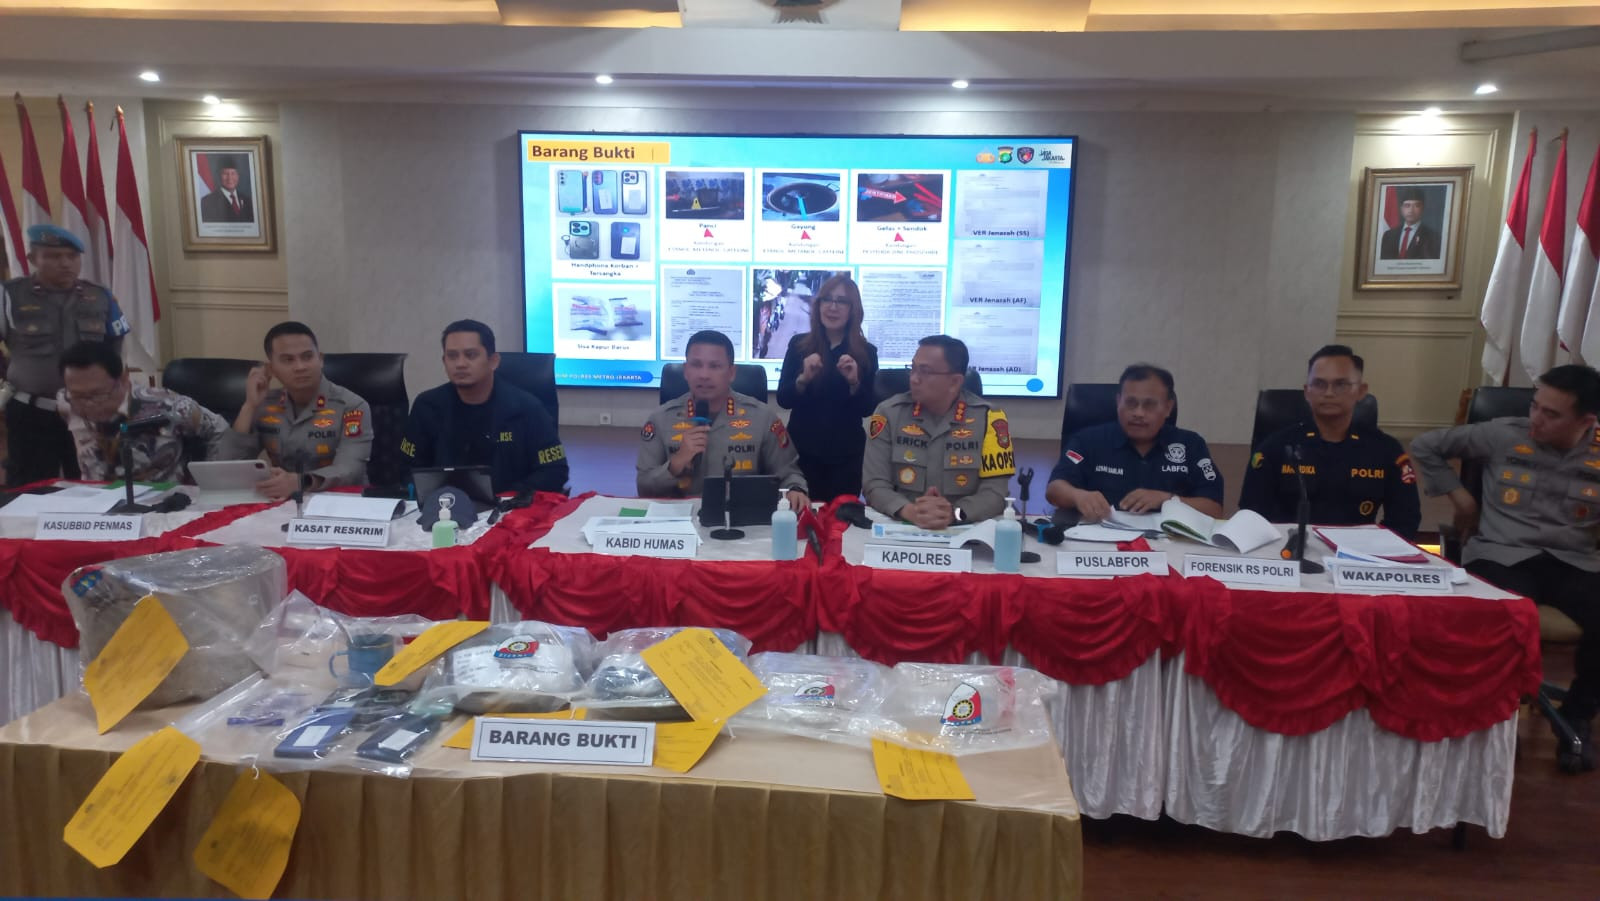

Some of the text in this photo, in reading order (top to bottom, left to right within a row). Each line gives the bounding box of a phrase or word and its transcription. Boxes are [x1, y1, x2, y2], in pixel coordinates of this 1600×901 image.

[532, 145, 635, 160] Barang Bukti
[308, 430, 336, 439] POLRI
[728, 444, 755, 453] POLRI
[896, 435, 929, 449] ERICK
[946, 440, 979, 450] POLRI
[1351, 468, 1384, 478] POLRI
[43, 519, 133, 531] KASUBBID PENMAS
[294, 523, 384, 537] KASAT RESKRIM
[606, 536, 685, 551] KABID HUMAS
[882, 550, 952, 566] KAPOLRES
[1075, 556, 1149, 568] PUSLABFOR
[1191, 561, 1294, 577] FORENSIK RS POLRI
[1342, 570, 1441, 584] WAKAPOLRES
[489, 729, 637, 749] BARANG BUKTI
